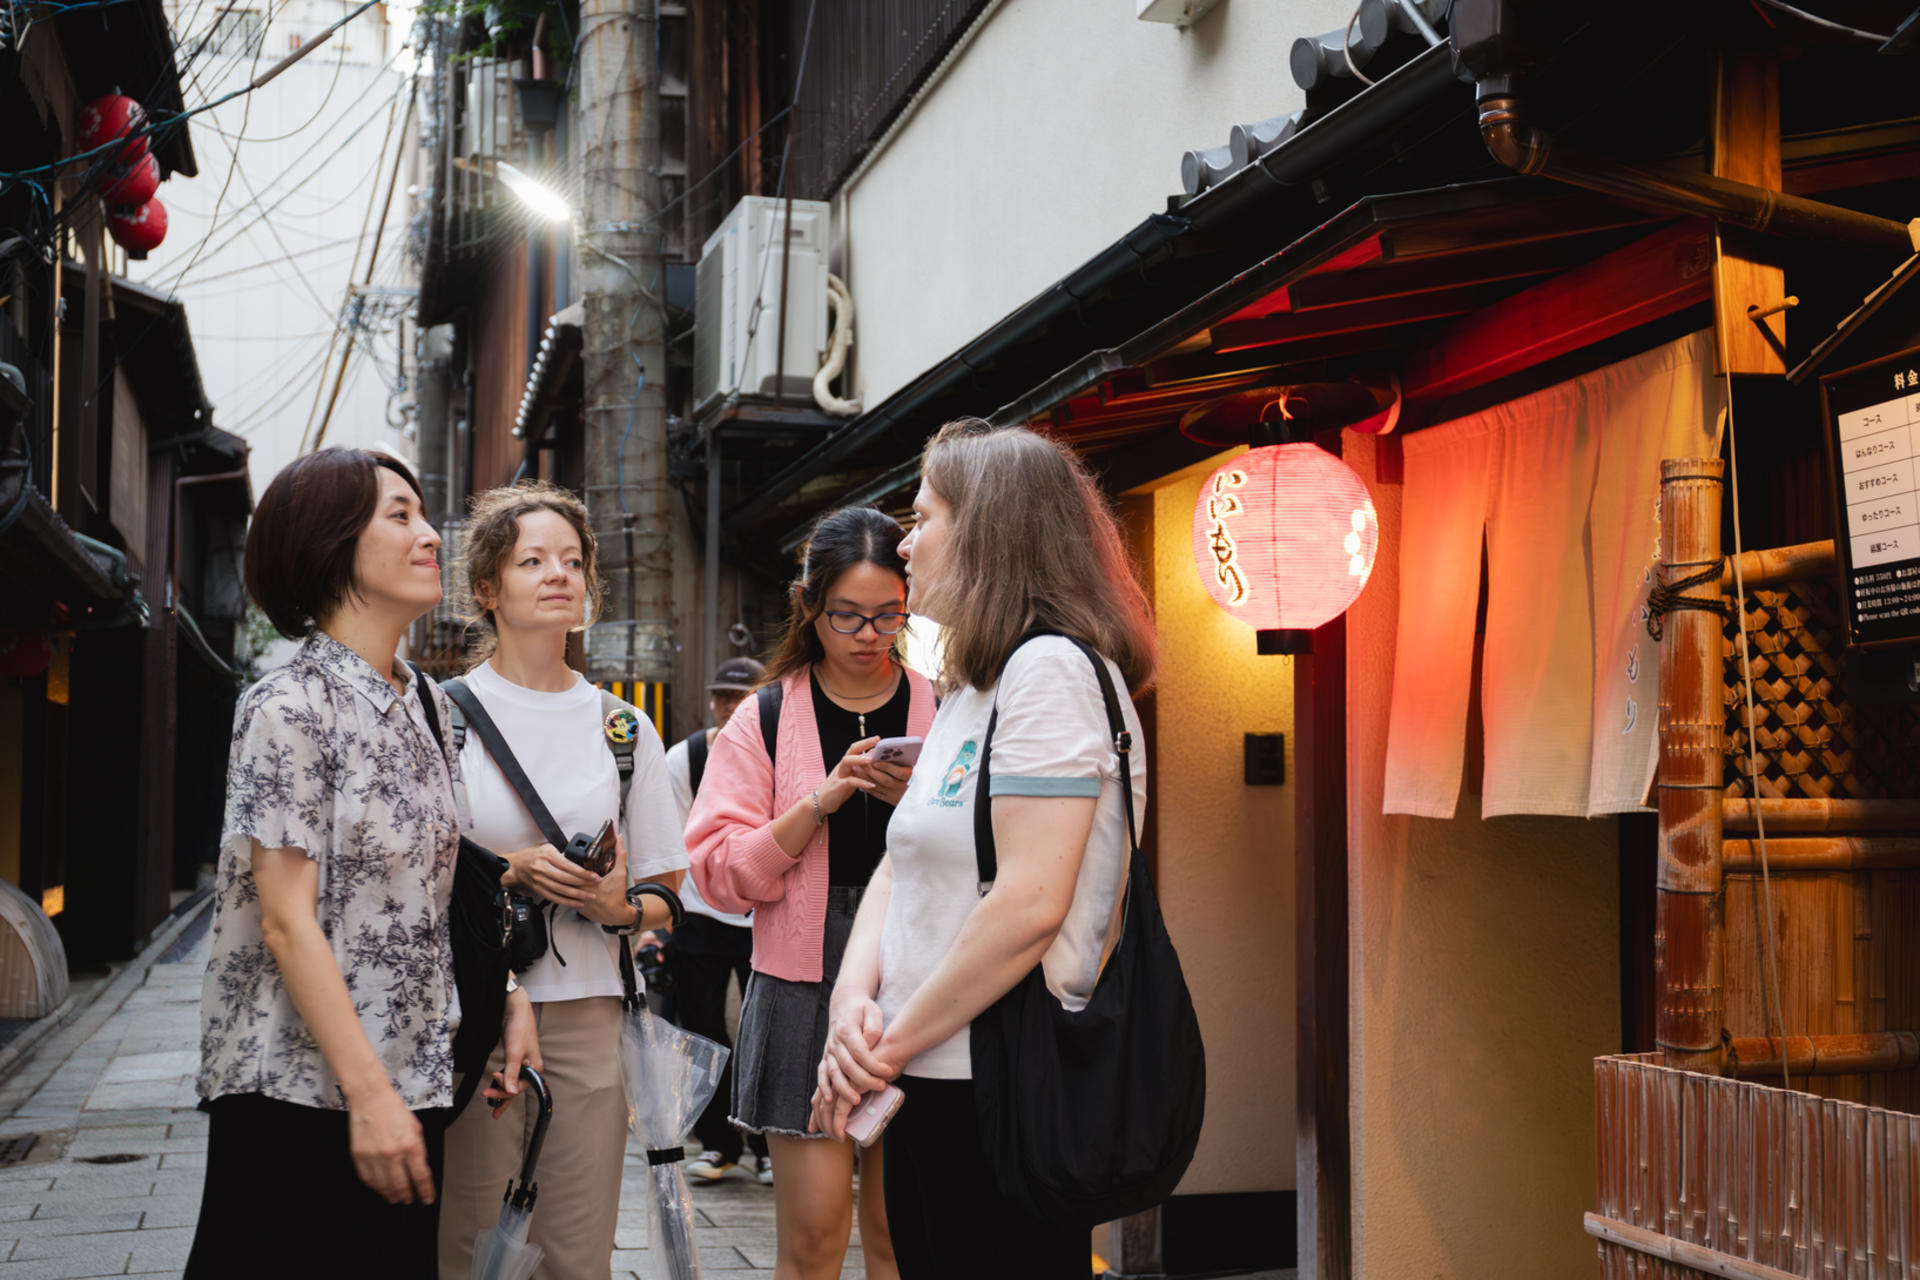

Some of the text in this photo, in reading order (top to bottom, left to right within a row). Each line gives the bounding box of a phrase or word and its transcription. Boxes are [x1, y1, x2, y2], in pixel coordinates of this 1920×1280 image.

[1894, 369, 1920, 390] 料金
[1863, 414, 1882, 427] コース
[1858, 474, 1898, 491] おすすめコース
[1862, 507, 1901, 522] ゆったりコース
